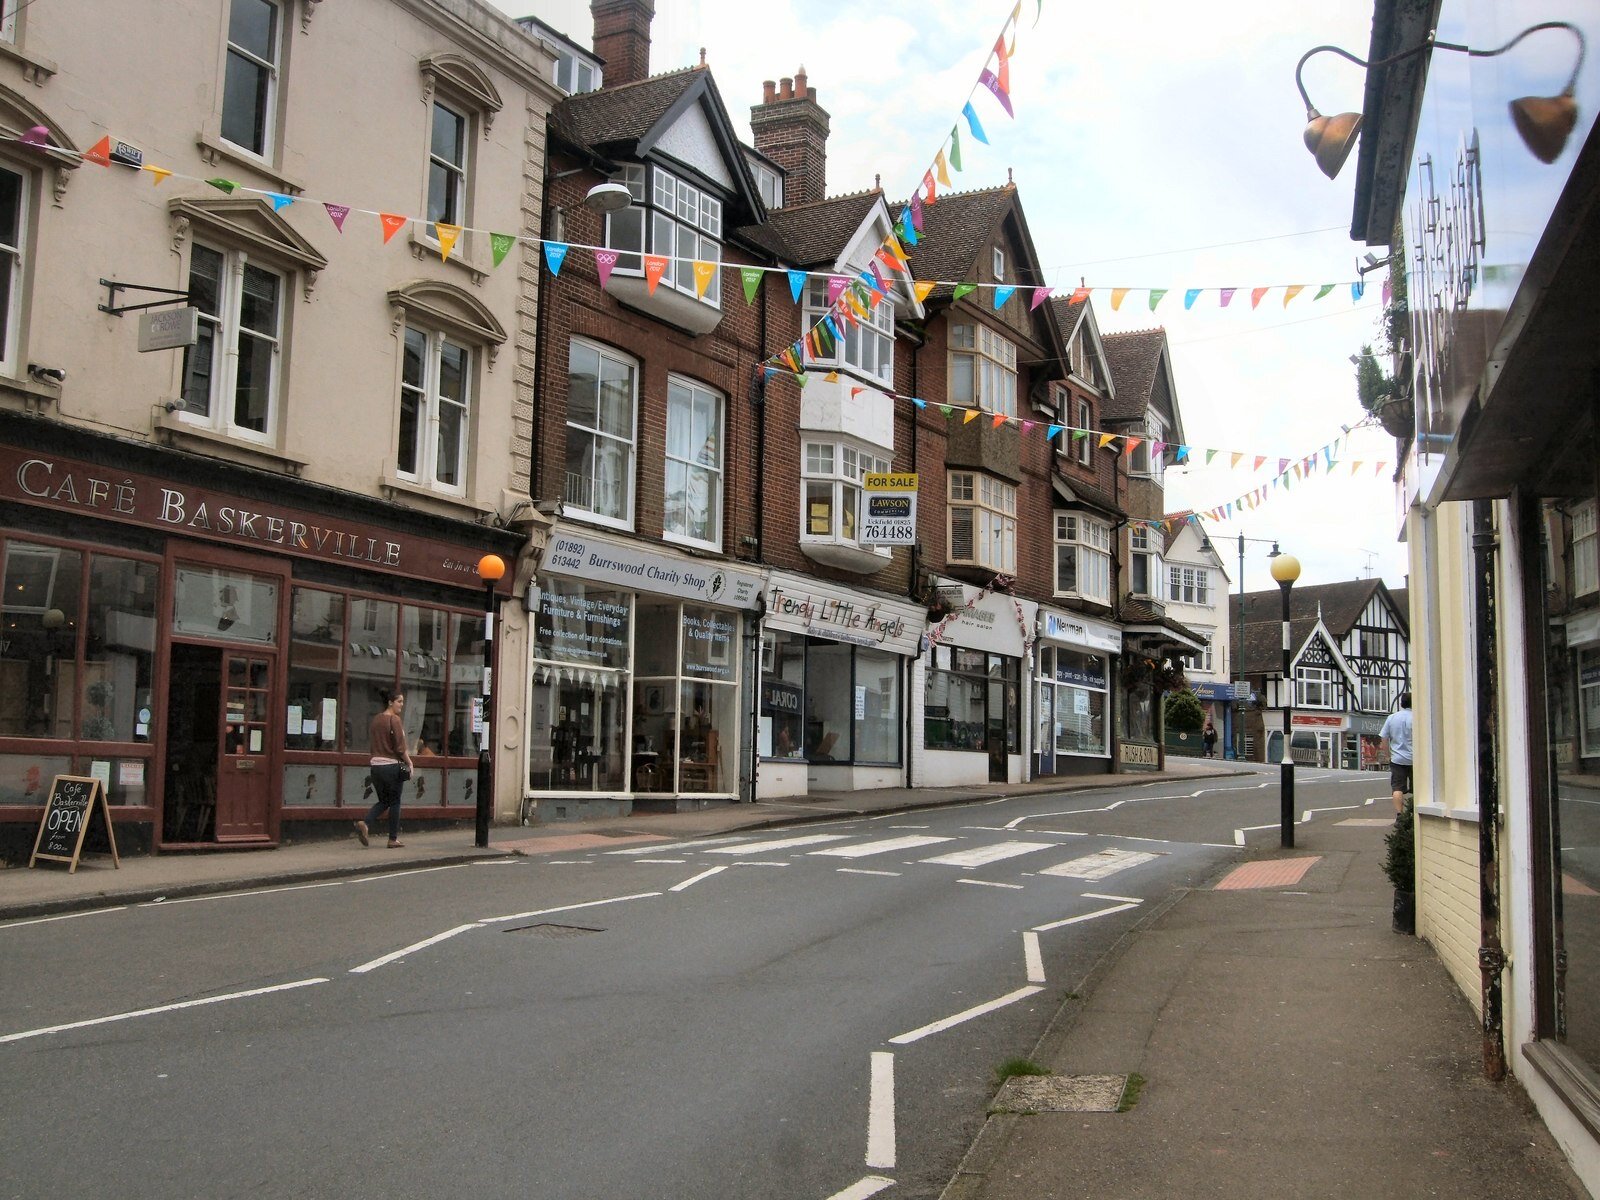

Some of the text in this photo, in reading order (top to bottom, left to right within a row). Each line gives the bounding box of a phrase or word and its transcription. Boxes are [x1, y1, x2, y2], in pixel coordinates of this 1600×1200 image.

[868, 478, 914, 487] FOR SALE
[872, 500, 909, 508] LAWSON
[16, 459, 401, 567] CAFÉ BASKERVILLE
[865, 525, 913, 539] 764488
[555, 540, 586, 558] (01892)
[552, 554, 581, 569] 613442
[589, 554, 645, 576] Burrswood
[647, 566, 681, 587] Charity
[683, 573, 705, 591] Shop
[543, 603, 620, 627] Furniture & Furnishings
[865, 606, 904, 643] Angels
[540, 627, 551, 636] Free
[553, 629, 577, 640] collection
[585, 633, 598, 643] large
[599, 636, 622, 645] donations
[694, 629, 713, 641] Quality
[64, 783, 83, 796] Café
[48, 809, 86, 832] OPEN
[50, 831, 66, 840] from
